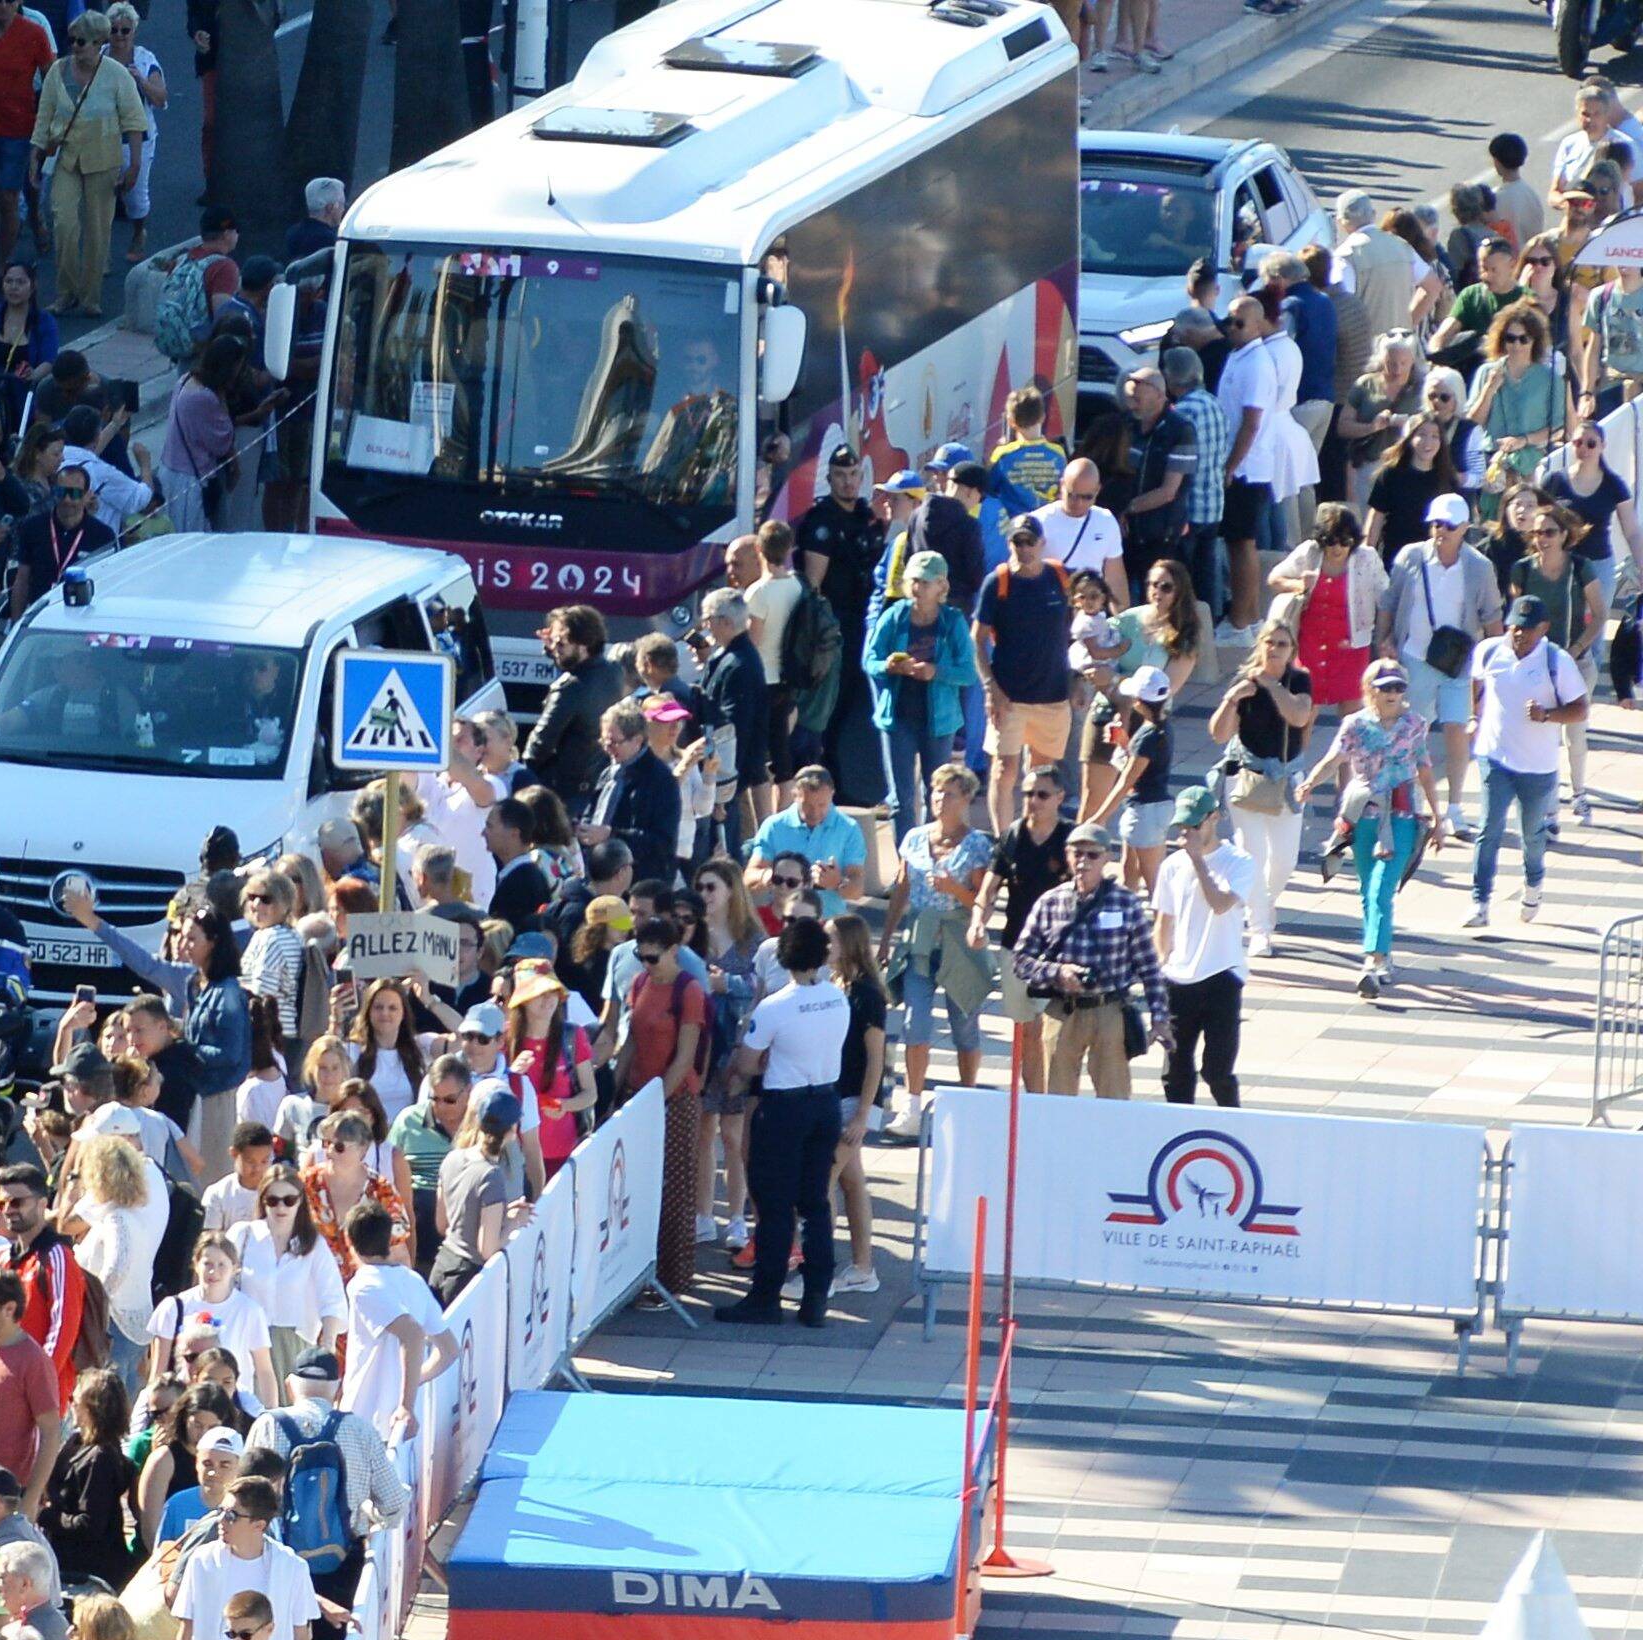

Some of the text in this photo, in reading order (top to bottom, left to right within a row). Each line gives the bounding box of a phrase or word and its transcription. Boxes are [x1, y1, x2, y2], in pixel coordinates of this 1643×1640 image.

[547, 260, 559, 275] 9
[365, 442, 384, 453] BUS
[480, 510, 564, 529] OTOKAR
[173, 637, 193, 650] 81
[181, 749, 202, 764] 7
[350, 930, 458, 961] ALLEZ MANU
[1103, 1231, 1302, 1259] VILLE DE SAINT-RAPHAËL
[611, 1571, 782, 1610] DIMA
